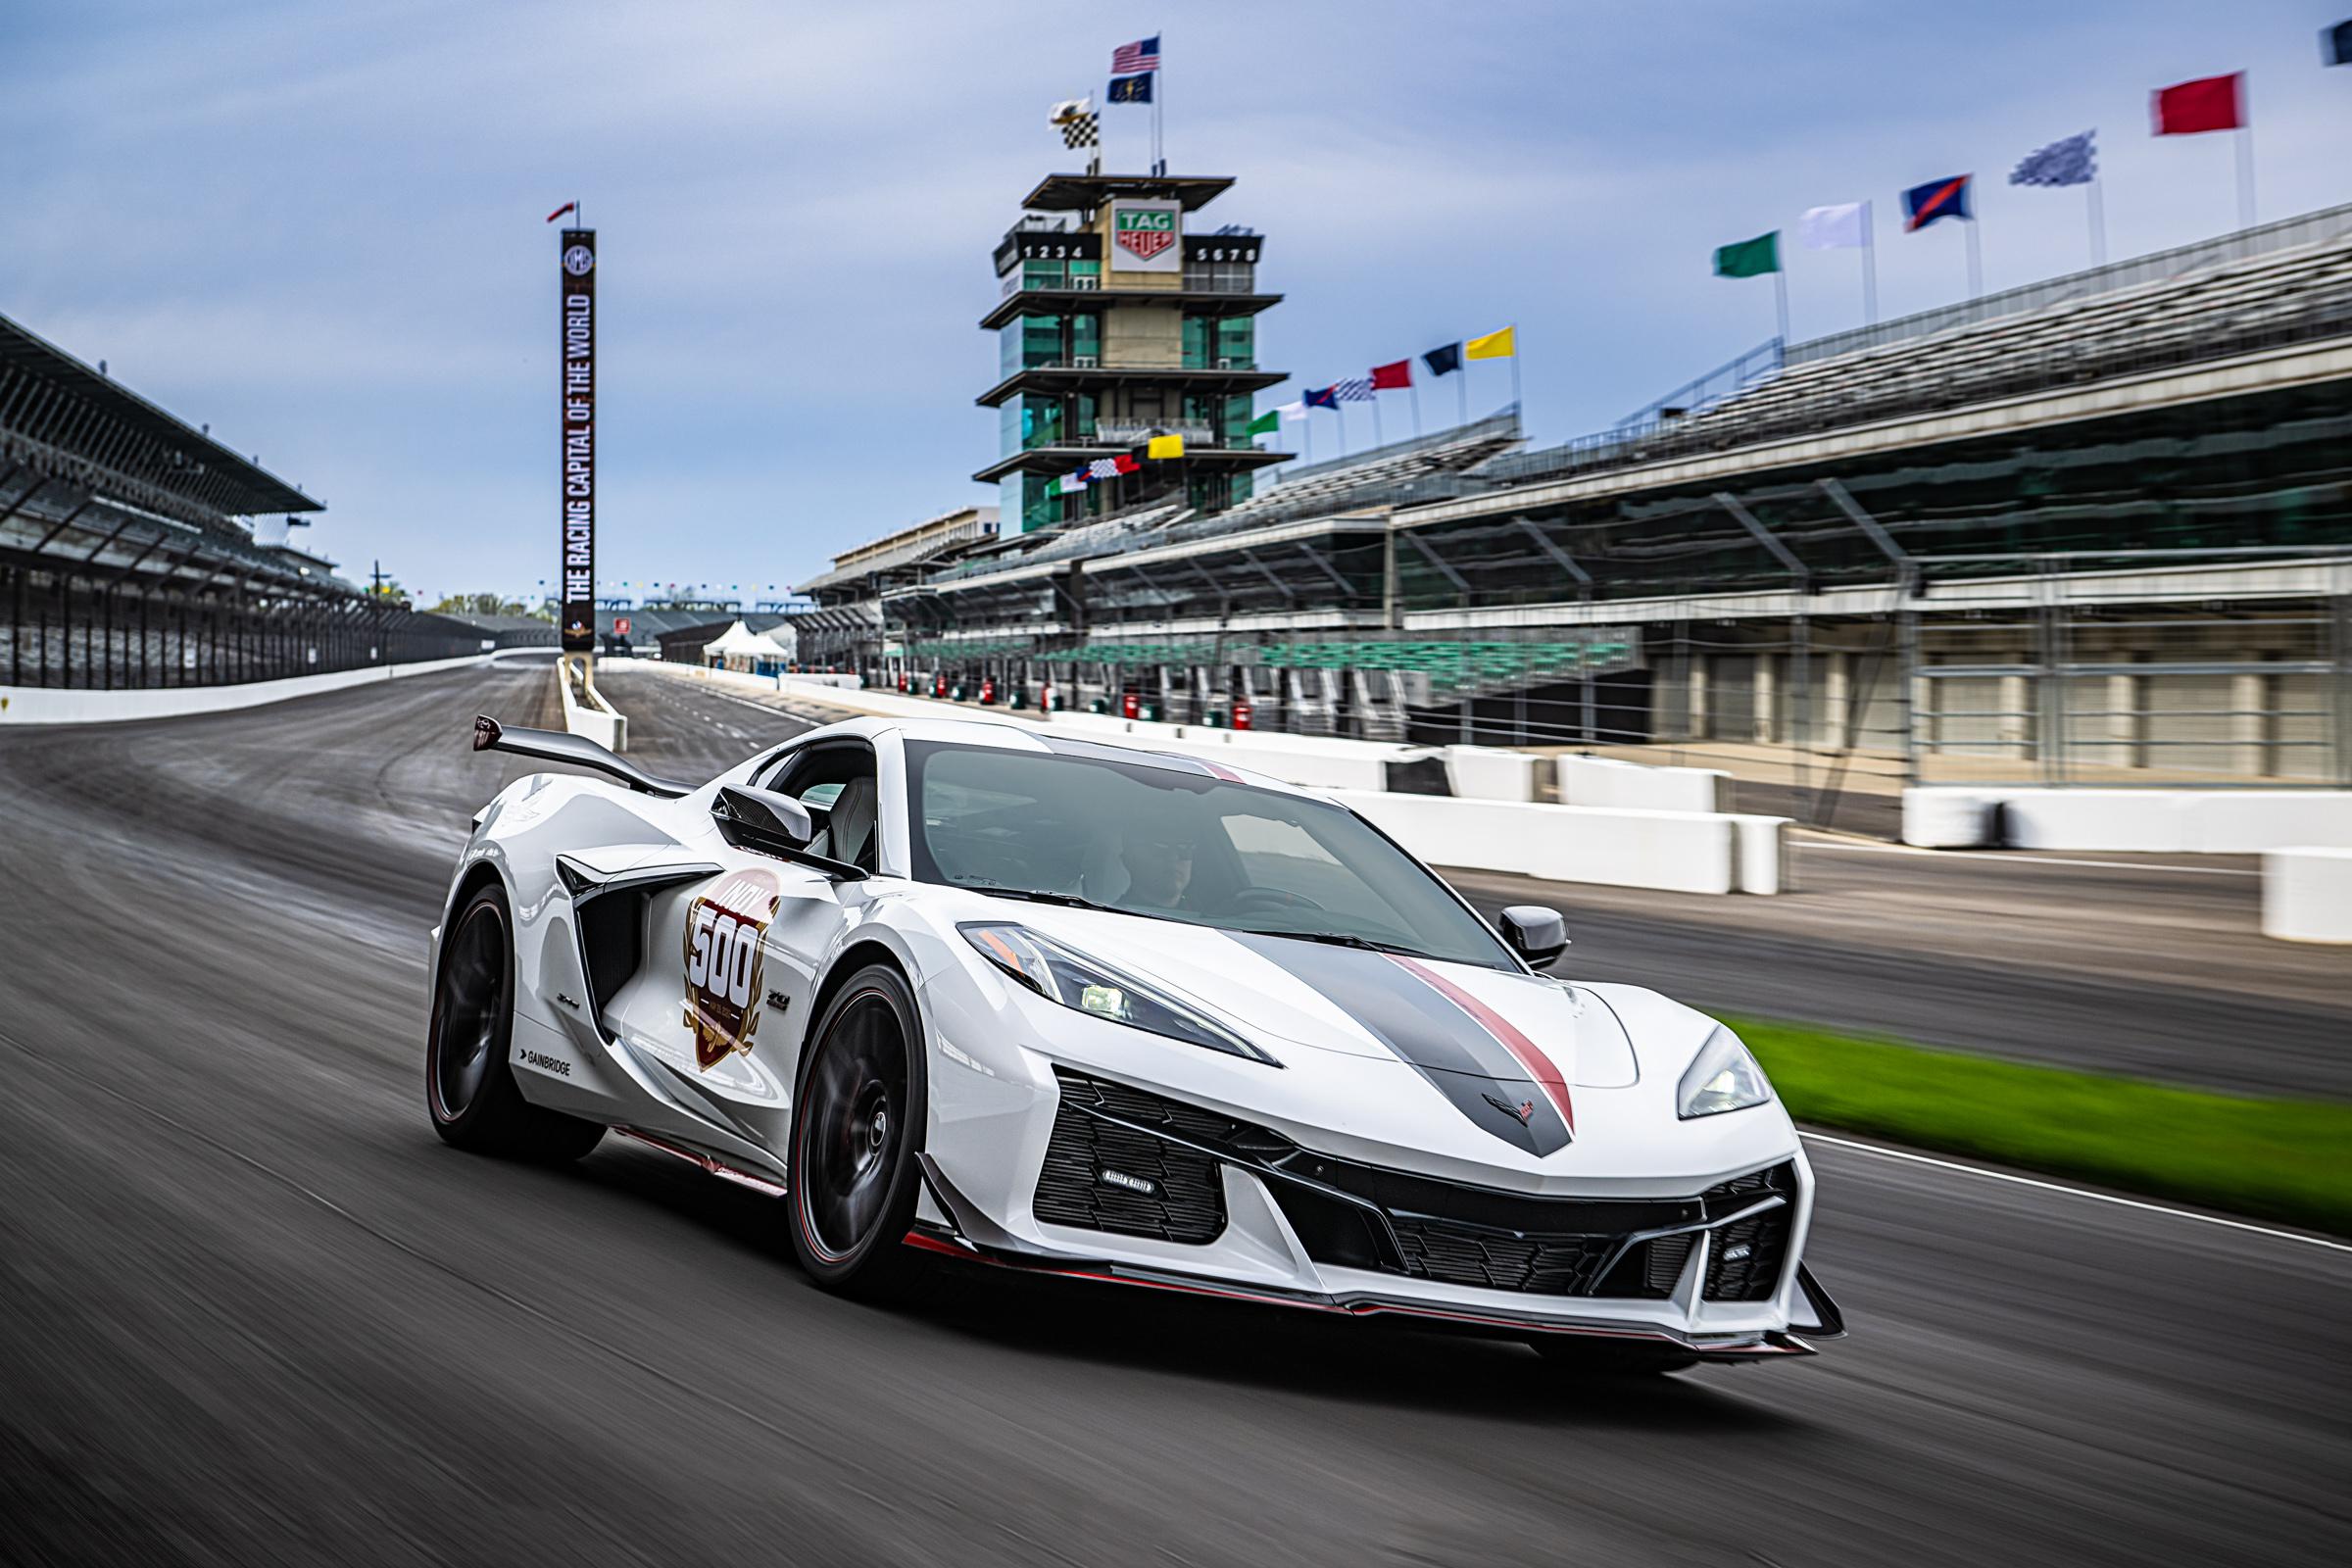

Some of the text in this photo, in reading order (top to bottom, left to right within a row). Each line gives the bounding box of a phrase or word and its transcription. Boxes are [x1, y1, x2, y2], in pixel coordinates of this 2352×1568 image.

[1121, 213, 1170, 229] TAG
[1024, 245, 1082, 259] 1 2 3 4
[1119, 231, 1173, 255] HEUER
[1197, 248, 1256, 262] 5 6 7 8
[566, 295, 591, 604] THE RACING CAPITAL OF THE WORLD
[689, 904, 759, 1009] 500
[527, 1051, 570, 1076] GAINBRIDGE
